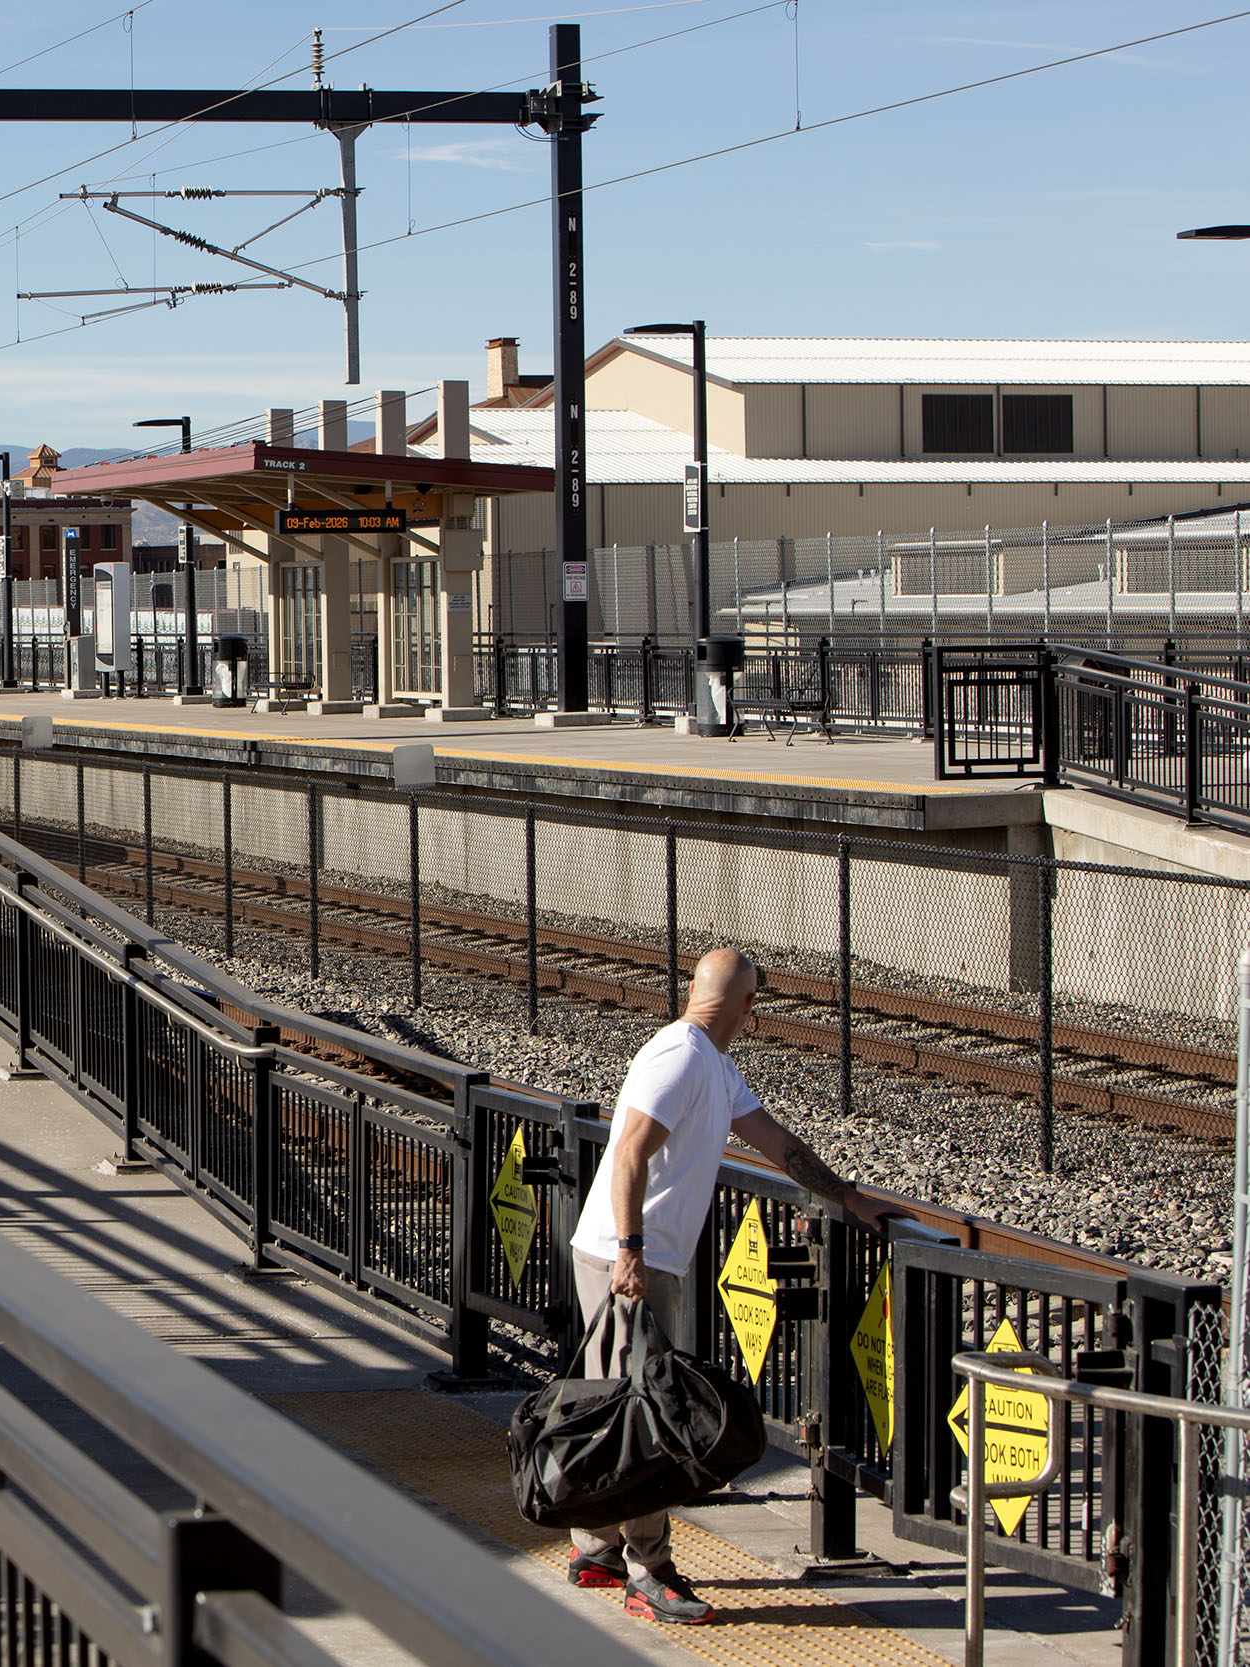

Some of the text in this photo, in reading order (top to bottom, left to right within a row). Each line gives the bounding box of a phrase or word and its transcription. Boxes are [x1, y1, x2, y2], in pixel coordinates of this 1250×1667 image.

[567, 216, 578, 320] N 2-89
[263, 459, 305, 470] TRACK 2
[570, 404, 580, 508] N 2-89
[286, 516, 400, 529] 09-Feb-2026 10:03 AM
[69, 549, 77, 609] EMERGENCY
[504, 1183, 528, 1203] CAUTION
[501, 1215, 530, 1241] LOOK BOTH
[509, 1241, 524, 1261] WAYS
[736, 1265, 767, 1285] CAUTION
[733, 1302, 771, 1329] LOOK BOTH
[744, 1331, 762, 1352] WAYS
[857, 1330, 869, 1349] DO
[870, 1336, 886, 1355] NOT
[867, 1355, 883, 1377] WHEN
[865, 1378, 878, 1398] ARE
[984, 1397, 1034, 1421] AUTION
[1009, 1446, 1040, 1471] BOTH
